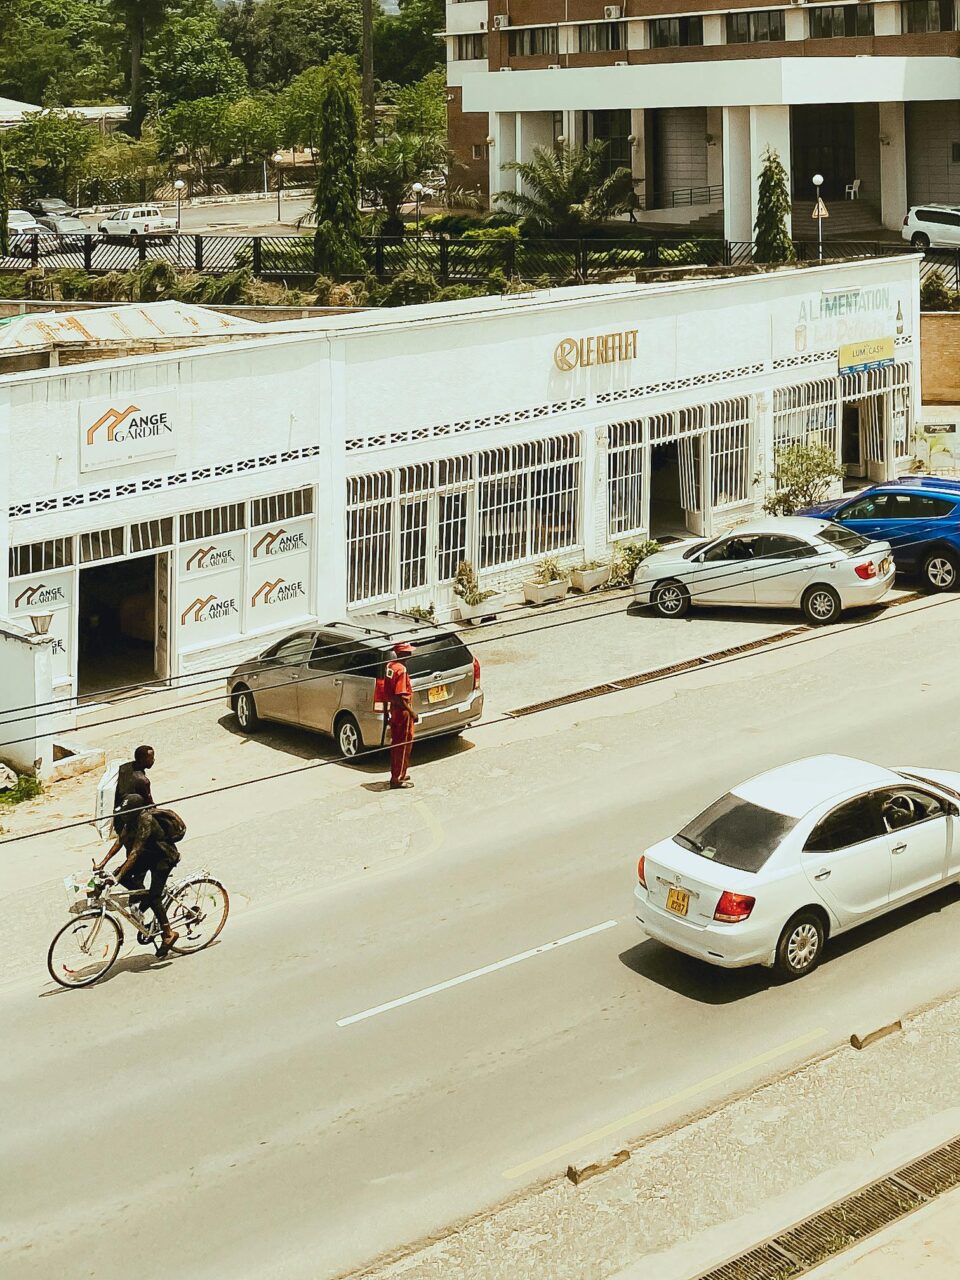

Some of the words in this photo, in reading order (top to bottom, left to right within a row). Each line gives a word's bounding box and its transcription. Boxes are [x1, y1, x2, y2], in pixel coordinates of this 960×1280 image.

[580, 336, 595, 368] LE
[596, 329, 639, 365] REFLET
[128, 412, 167, 430] ANGE
[114, 421, 173, 442] GARDIEN
[279, 532, 304, 545] ANGE
[209, 549, 232, 561] ANGE
[39, 586, 62, 597] ANGE
[277, 581, 303, 594] ANGE
[208, 598, 235, 613] ANGE
